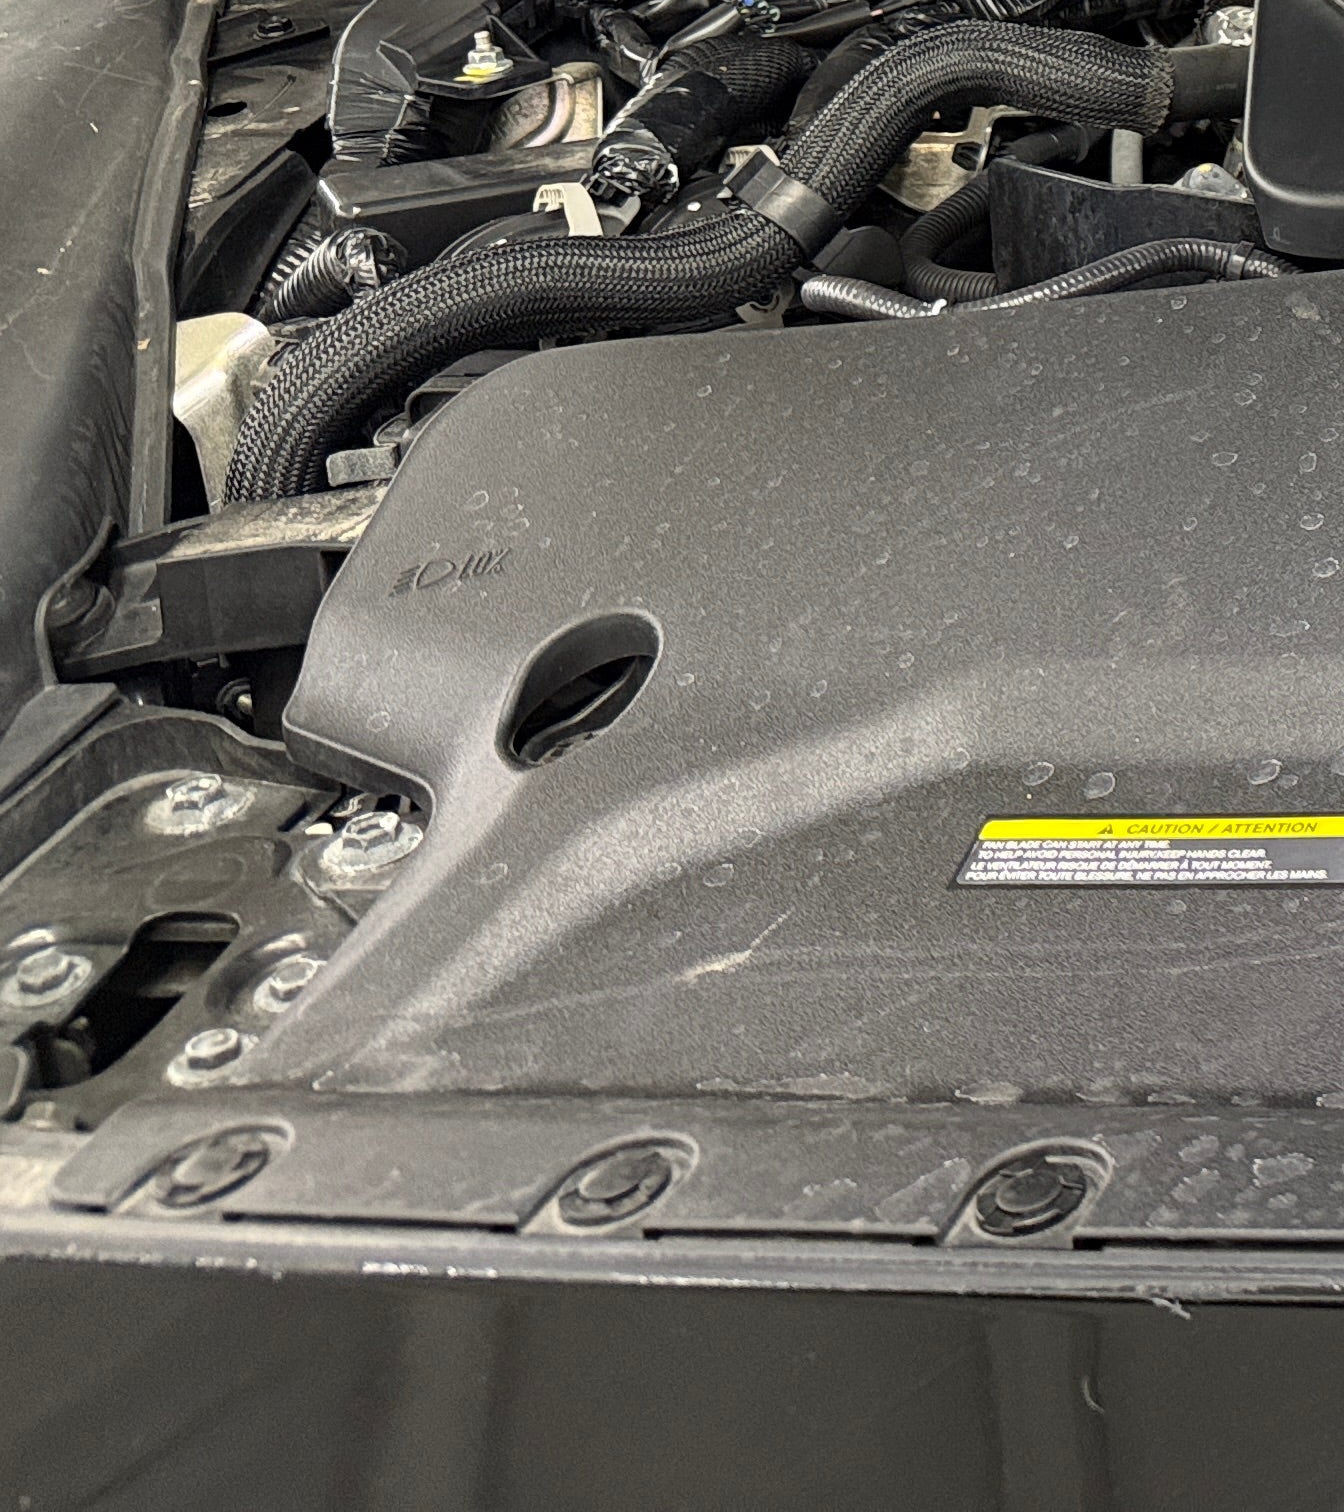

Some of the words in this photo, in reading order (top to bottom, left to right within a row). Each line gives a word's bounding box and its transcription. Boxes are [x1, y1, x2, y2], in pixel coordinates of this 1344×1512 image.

[1126, 823, 1204, 835] CAUTION
[1222, 821, 1318, 834] ATTENTION
[982, 841, 1005, 849] FAN
[1006, 841, 1041, 849] BLADE
[1042, 841, 1067, 849] CAN
[1068, 841, 1103, 849] START
[1103, 841, 1118, 849] AT
[1118, 840, 1142, 849] ANY
[978, 850, 993, 859] TO
[996, 850, 1024, 859] HELP
[1023, 850, 1058, 859] AVOID
[1058, 850, 1117, 859] PERSONAL
[1186, 849, 1226, 859] HANDS
[970, 861, 985, 871] LE
[987, 861, 1057, 871] VENTILATEUR
[1057, 861, 1099, 871] RISQUE
[1100, 861, 1116, 870] DE
[1191, 860, 1221, 870] TOUT
[965, 871, 998, 881] POUR
[1037, 871, 1074, 881] TOUTE
[1136, 871, 1153, 881] NE
[1154, 871, 1177, 881] PAS
[1178, 871, 1196, 881] EN
[1195, 871, 1266, 881] APPROCHER
[1266, 870, 1289, 880] LES
